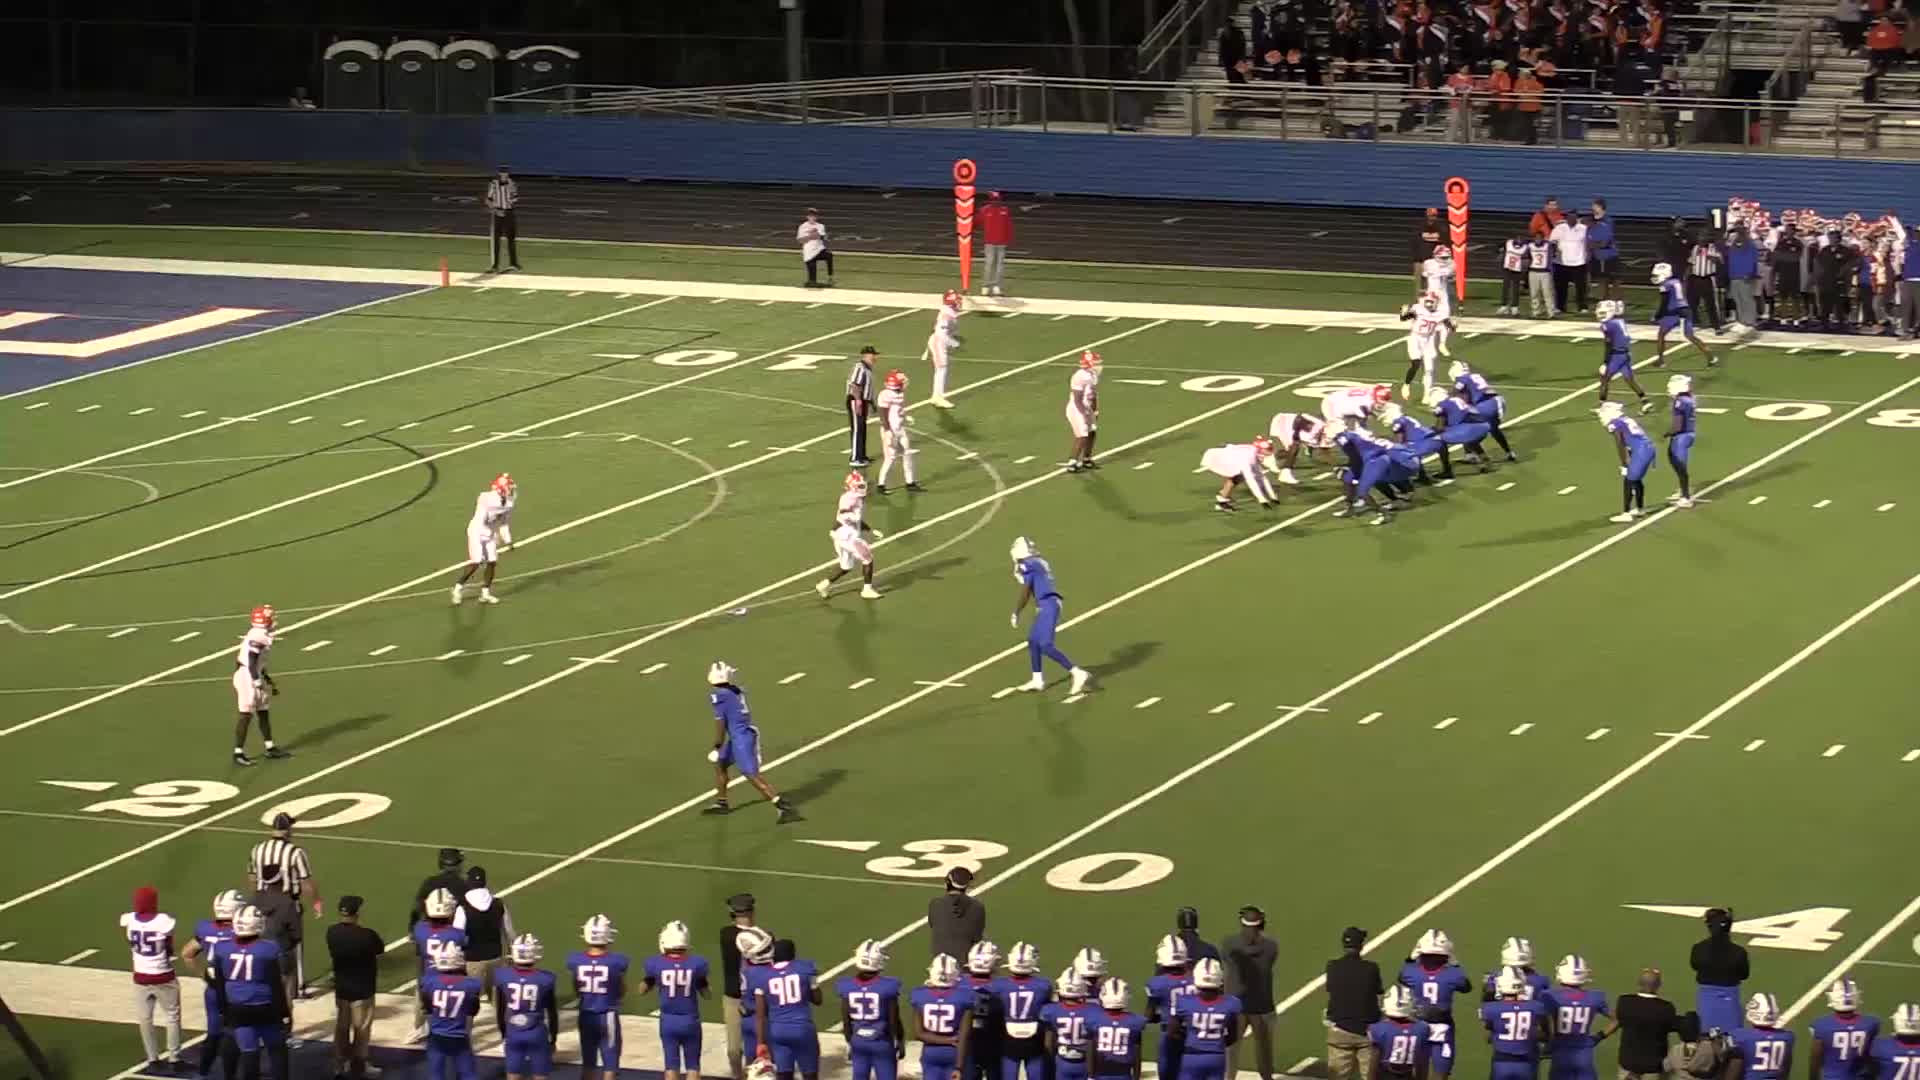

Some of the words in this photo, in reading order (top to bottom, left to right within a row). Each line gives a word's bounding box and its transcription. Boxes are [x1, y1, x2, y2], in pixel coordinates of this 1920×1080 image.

[228, 953, 254, 981] 71
[577, 965, 609, 993] 52
[506, 982, 538, 1012] 39
[660, 969, 693, 998] 94
[769, 974, 801, 1006] 90
[1422, 982, 1439, 1005] 9
[432, 990, 466, 1018] 47
[849, 991, 880, 1021] 53
[923, 1004, 955, 1033] 62
[1009, 991, 1034, 1020] 17
[1191, 1012, 1225, 1040] 45
[1499, 1011, 1532, 1041] 38
[1556, 1006, 1591, 1035] 84
[1752, 1041, 1785, 1071] 50
[1832, 1031, 1866, 1060] 99
